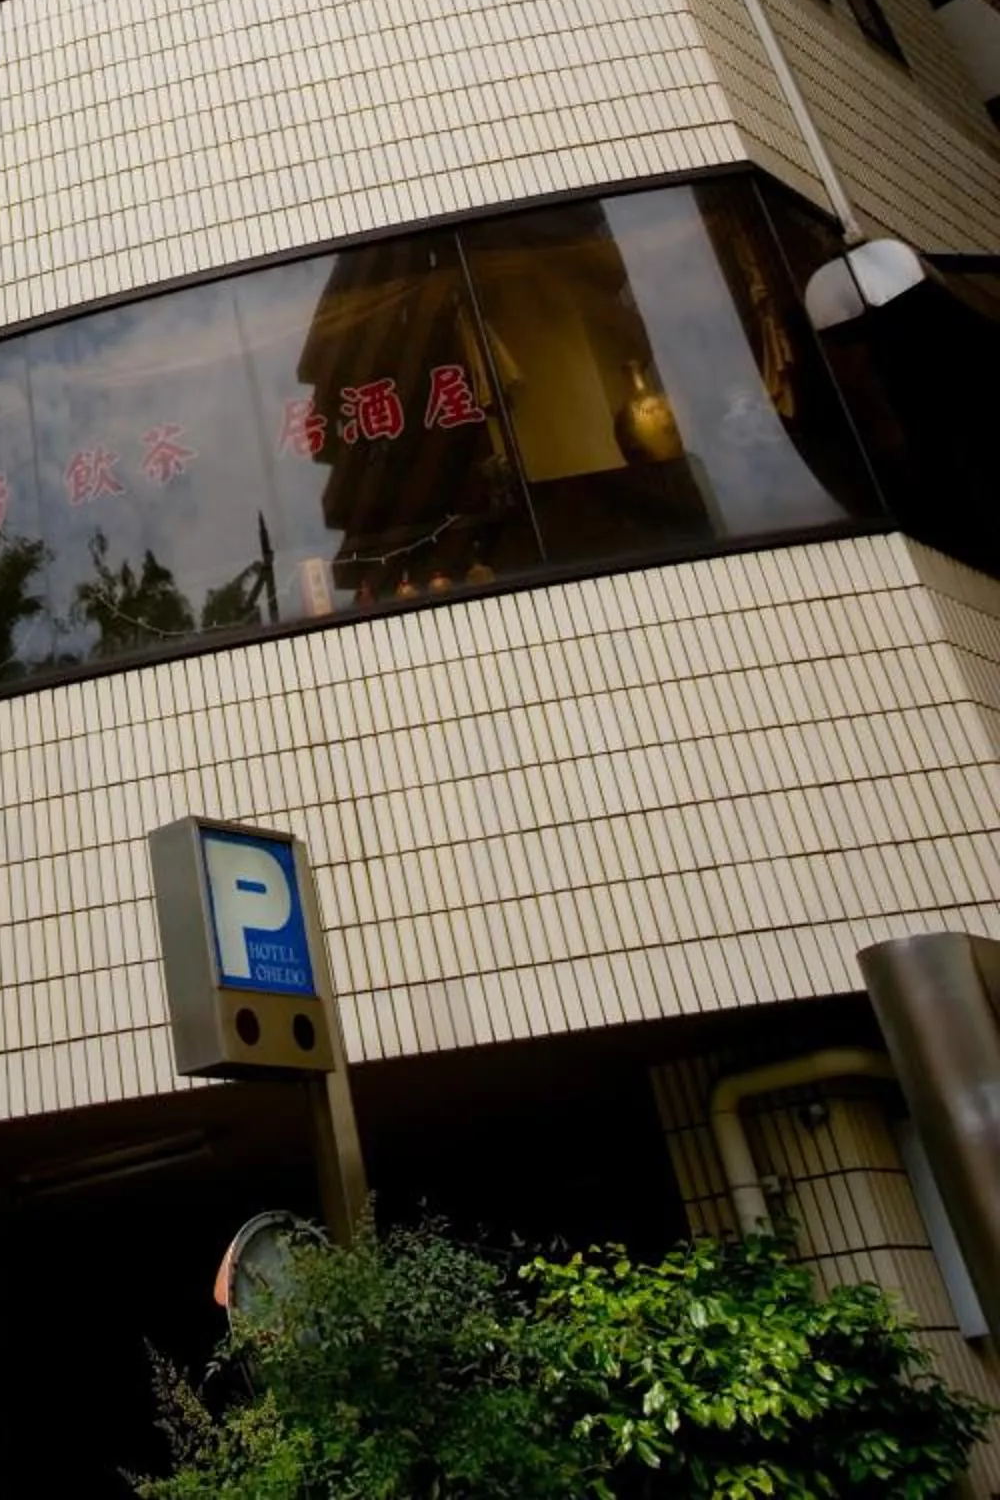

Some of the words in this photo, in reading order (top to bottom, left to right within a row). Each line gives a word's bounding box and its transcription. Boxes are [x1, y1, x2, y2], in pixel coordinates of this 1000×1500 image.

[66, 421, 197, 502] 飲茶
[278, 365, 486, 459] 居酒屋
[203, 838, 292, 979] P
[249, 941, 299, 963] HOTEL
